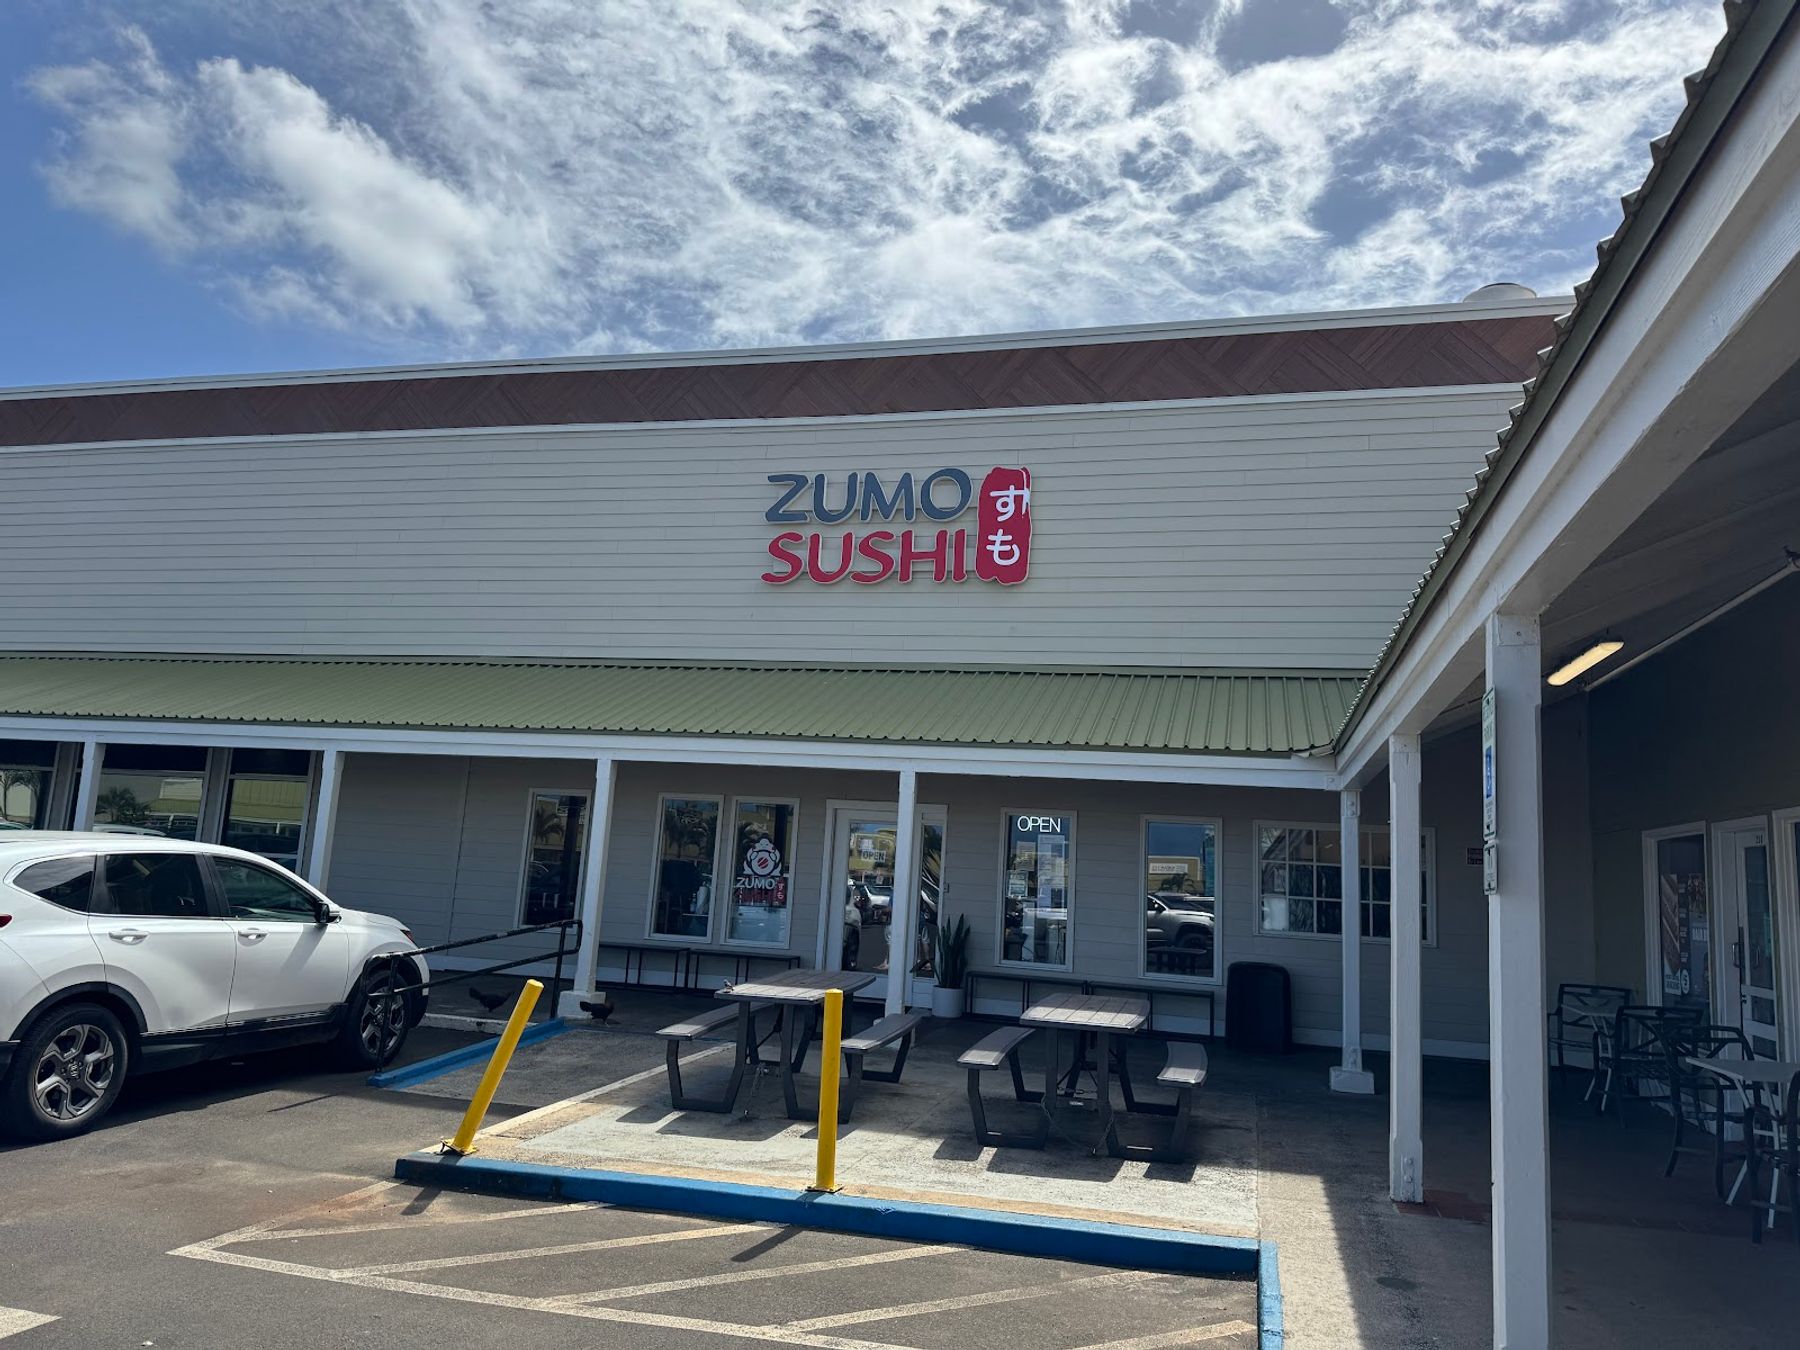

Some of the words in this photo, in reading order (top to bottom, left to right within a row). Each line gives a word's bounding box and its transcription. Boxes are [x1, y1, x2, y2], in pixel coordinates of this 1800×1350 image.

[764, 467, 973, 524] ZUMO
[986, 484, 1030, 566] すも
[760, 528, 968, 584] SUSHI
[1017, 815, 1061, 833] OPEN
[862, 850, 885, 861] OPEN
[736, 877, 775, 890] ZUMO
